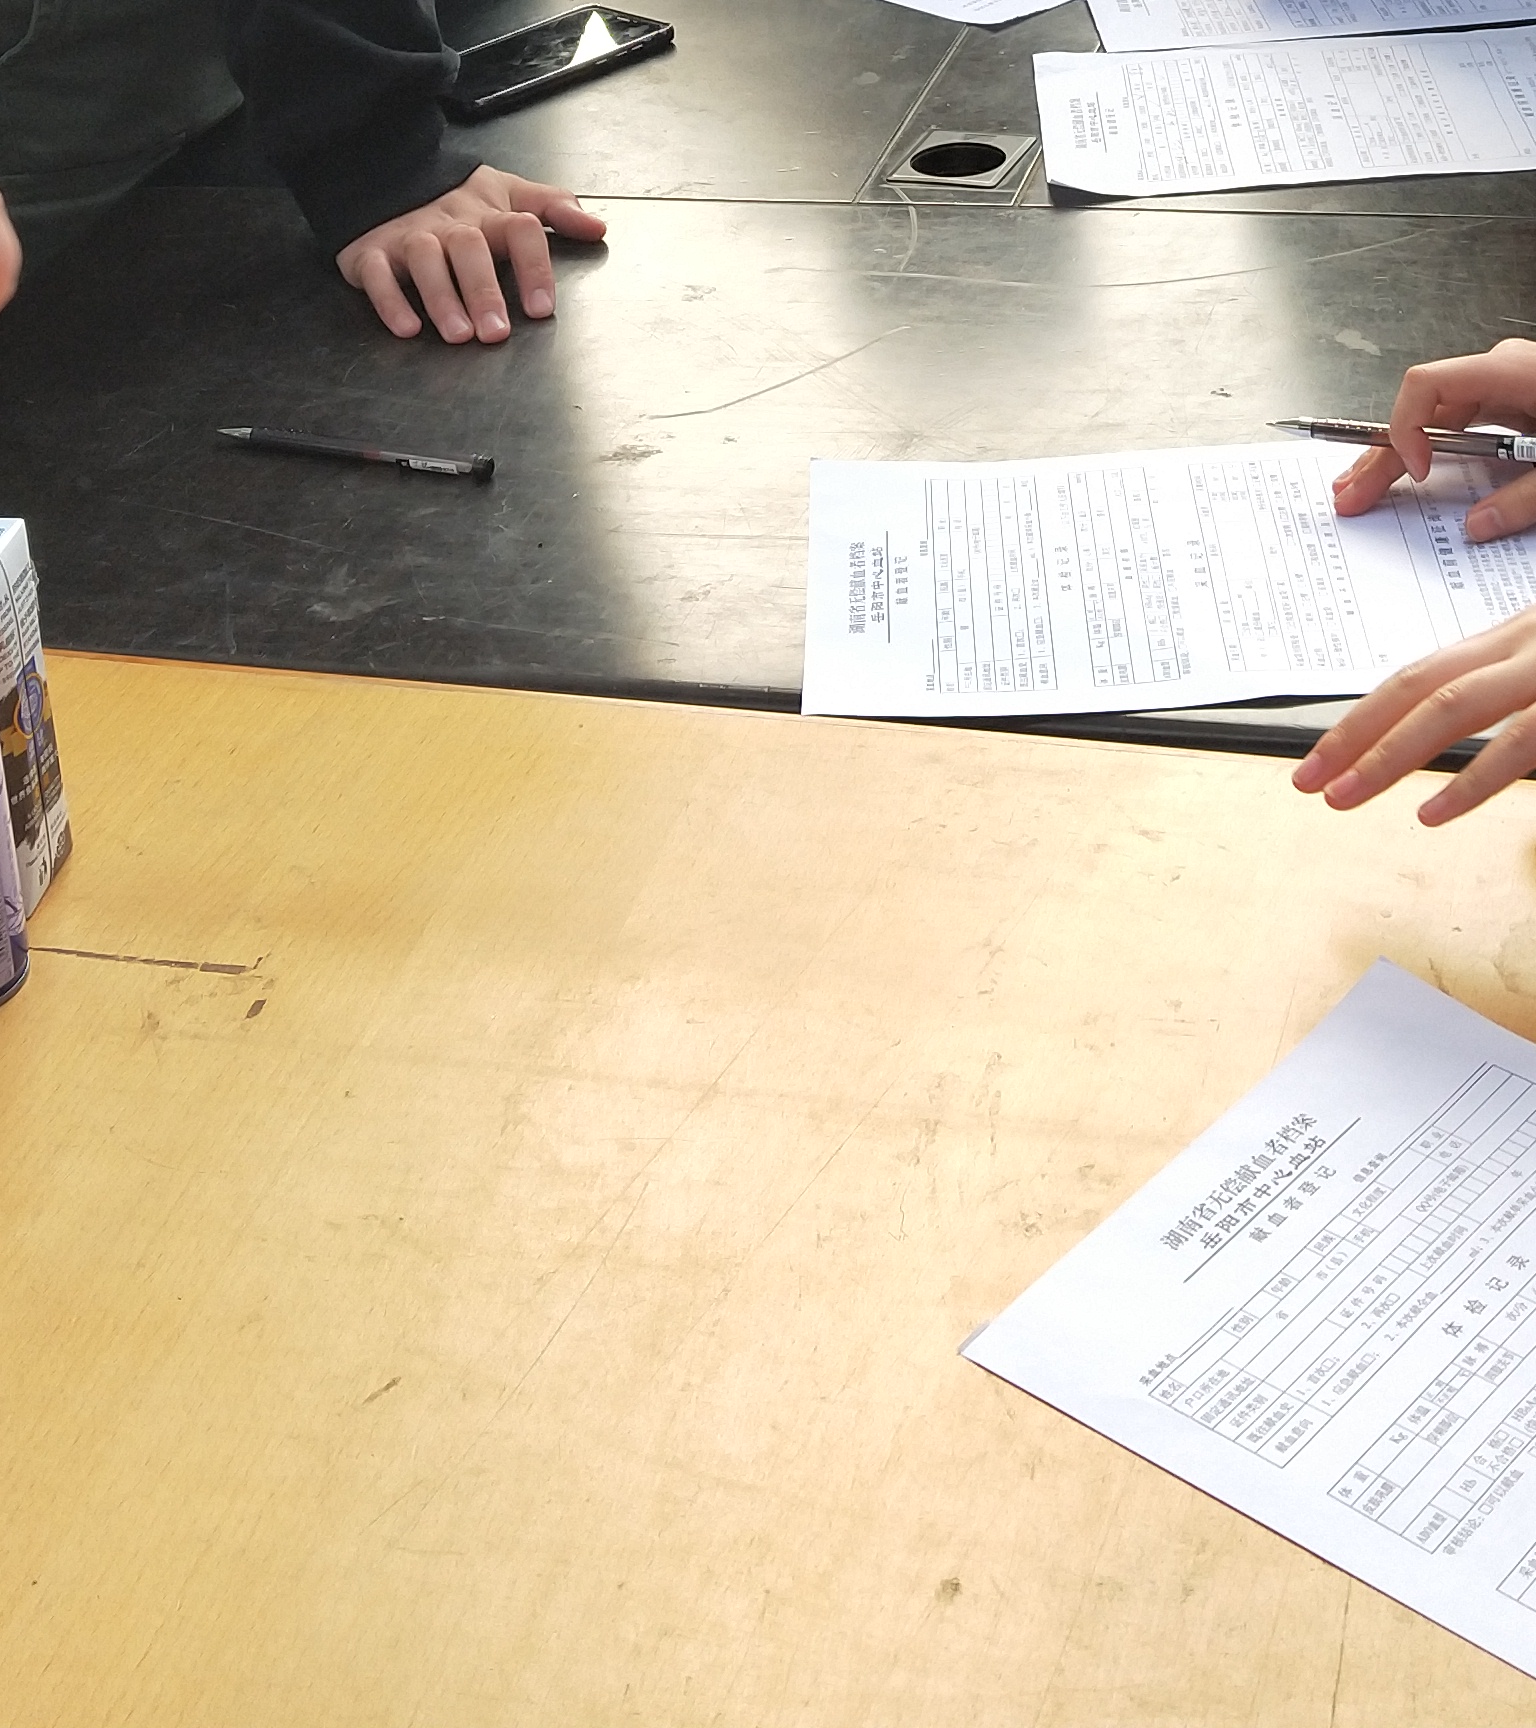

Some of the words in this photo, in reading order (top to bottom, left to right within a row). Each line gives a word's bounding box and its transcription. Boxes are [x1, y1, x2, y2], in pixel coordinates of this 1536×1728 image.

[1156, 1109, 1320, 1252] 湖南省无偿献血者档案
[1350, 1151, 1390, 1184] 信息查询
[1194, 1132, 1328, 1252] 岳阳市中心血站
[1245, 1162, 1338, 1244] 献血者登记
[1349, 1185, 1388, 1218] 文化程度
[1311, 1232, 1337, 1252] 民族
[1350, 1225, 1376, 1245] 手机
[1417, 1222, 1471, 1271] 上次献血时间
[1268, 1275, 1294, 1295] 年龄
[1337, 1272, 1389, 1319] 证件号码
[1438, 1251, 1533, 1340] 体检记录
[1228, 1313, 1255, 1334] 性别
[1272, 1308, 1292, 1322] 省
[1136, 1350, 1179, 1387] 采血地点
[1157, 1380, 1183, 1401] 姓名
[1182, 1365, 1232, 1409] 户口所在地
[1198, 1373, 1256, 1425] 固定通讯地址
[1227, 1392, 1270, 1430] 证件类别
[1244, 1399, 1296, 1445] 既往献血史
[1405, 1402, 1432, 1425] 体温
[1272, 1415, 1315, 1454] 献血意向
[1387, 1429, 1410, 1446] Kg
[1484, 1443, 1518, 1474] 不合格
[1335, 1468, 1371, 1500] 体重
